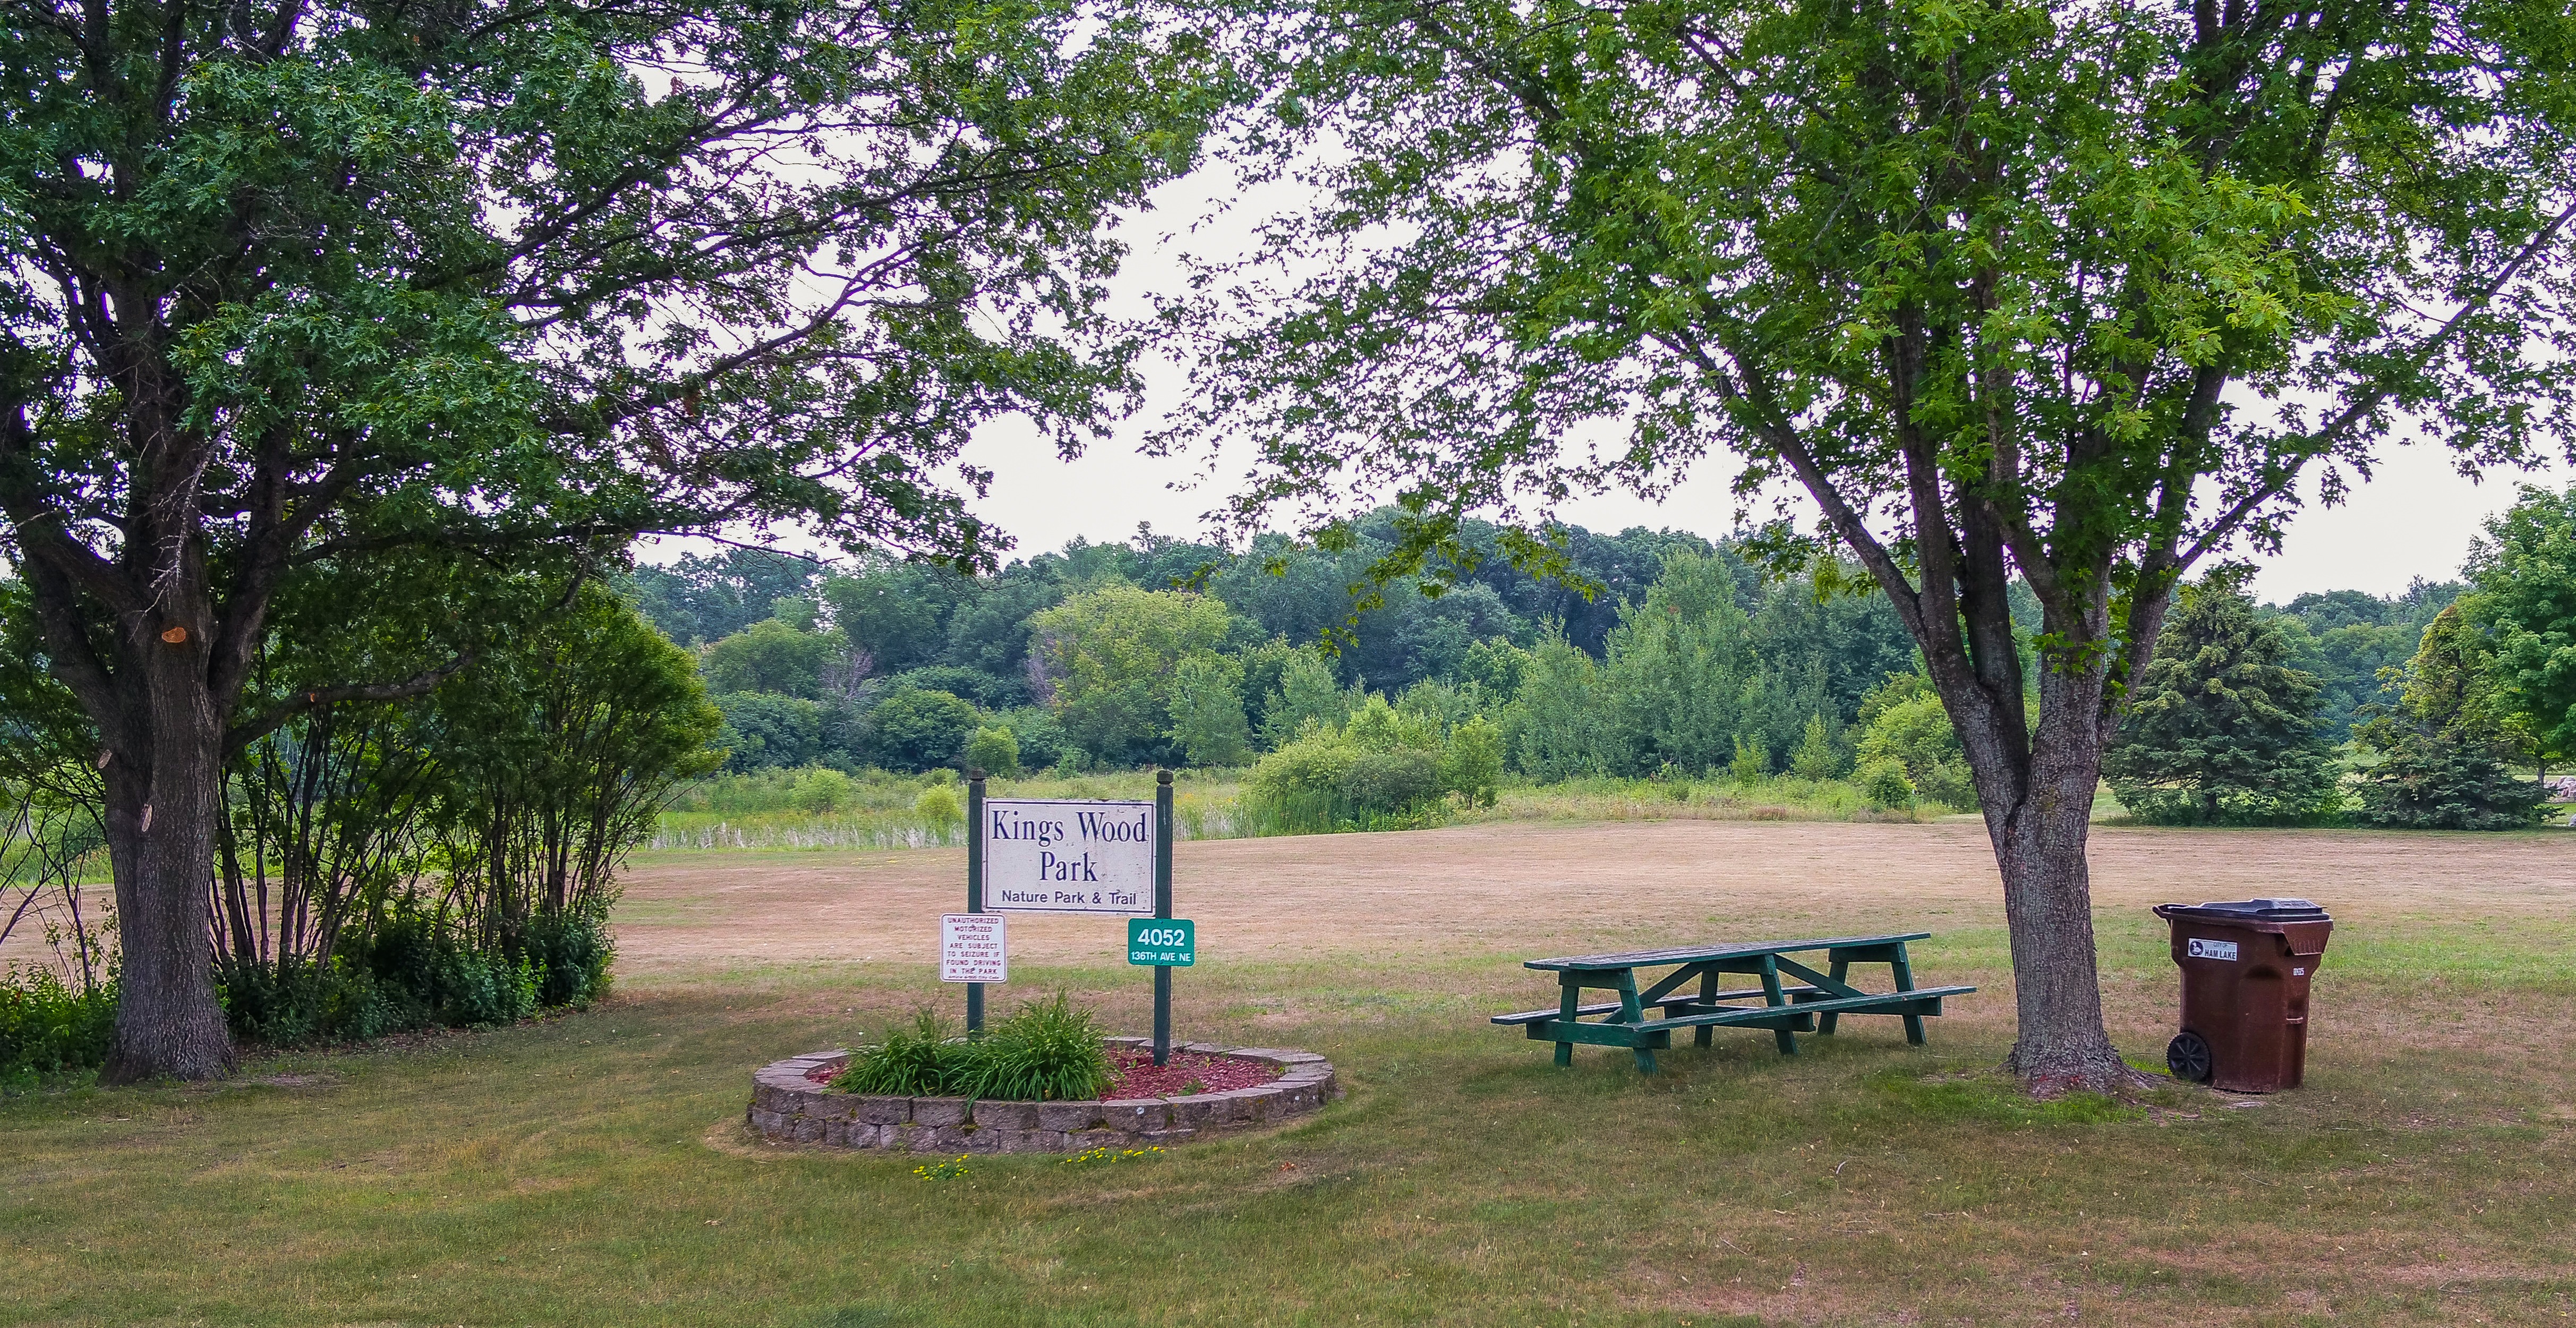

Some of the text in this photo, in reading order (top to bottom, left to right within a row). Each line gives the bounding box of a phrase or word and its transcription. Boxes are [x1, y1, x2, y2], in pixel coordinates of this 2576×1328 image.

[992, 810, 1147, 847] Kings Wood
[1039, 851, 1099, 882] Park
[1002, 890, 1137, 905] Nature Park & Trail
[1137, 929, 1185, 947] 4052
[1131, 951, 1191, 961] 136TH AVE NE
[2205, 949, 2236, 959] HAM LAKE
